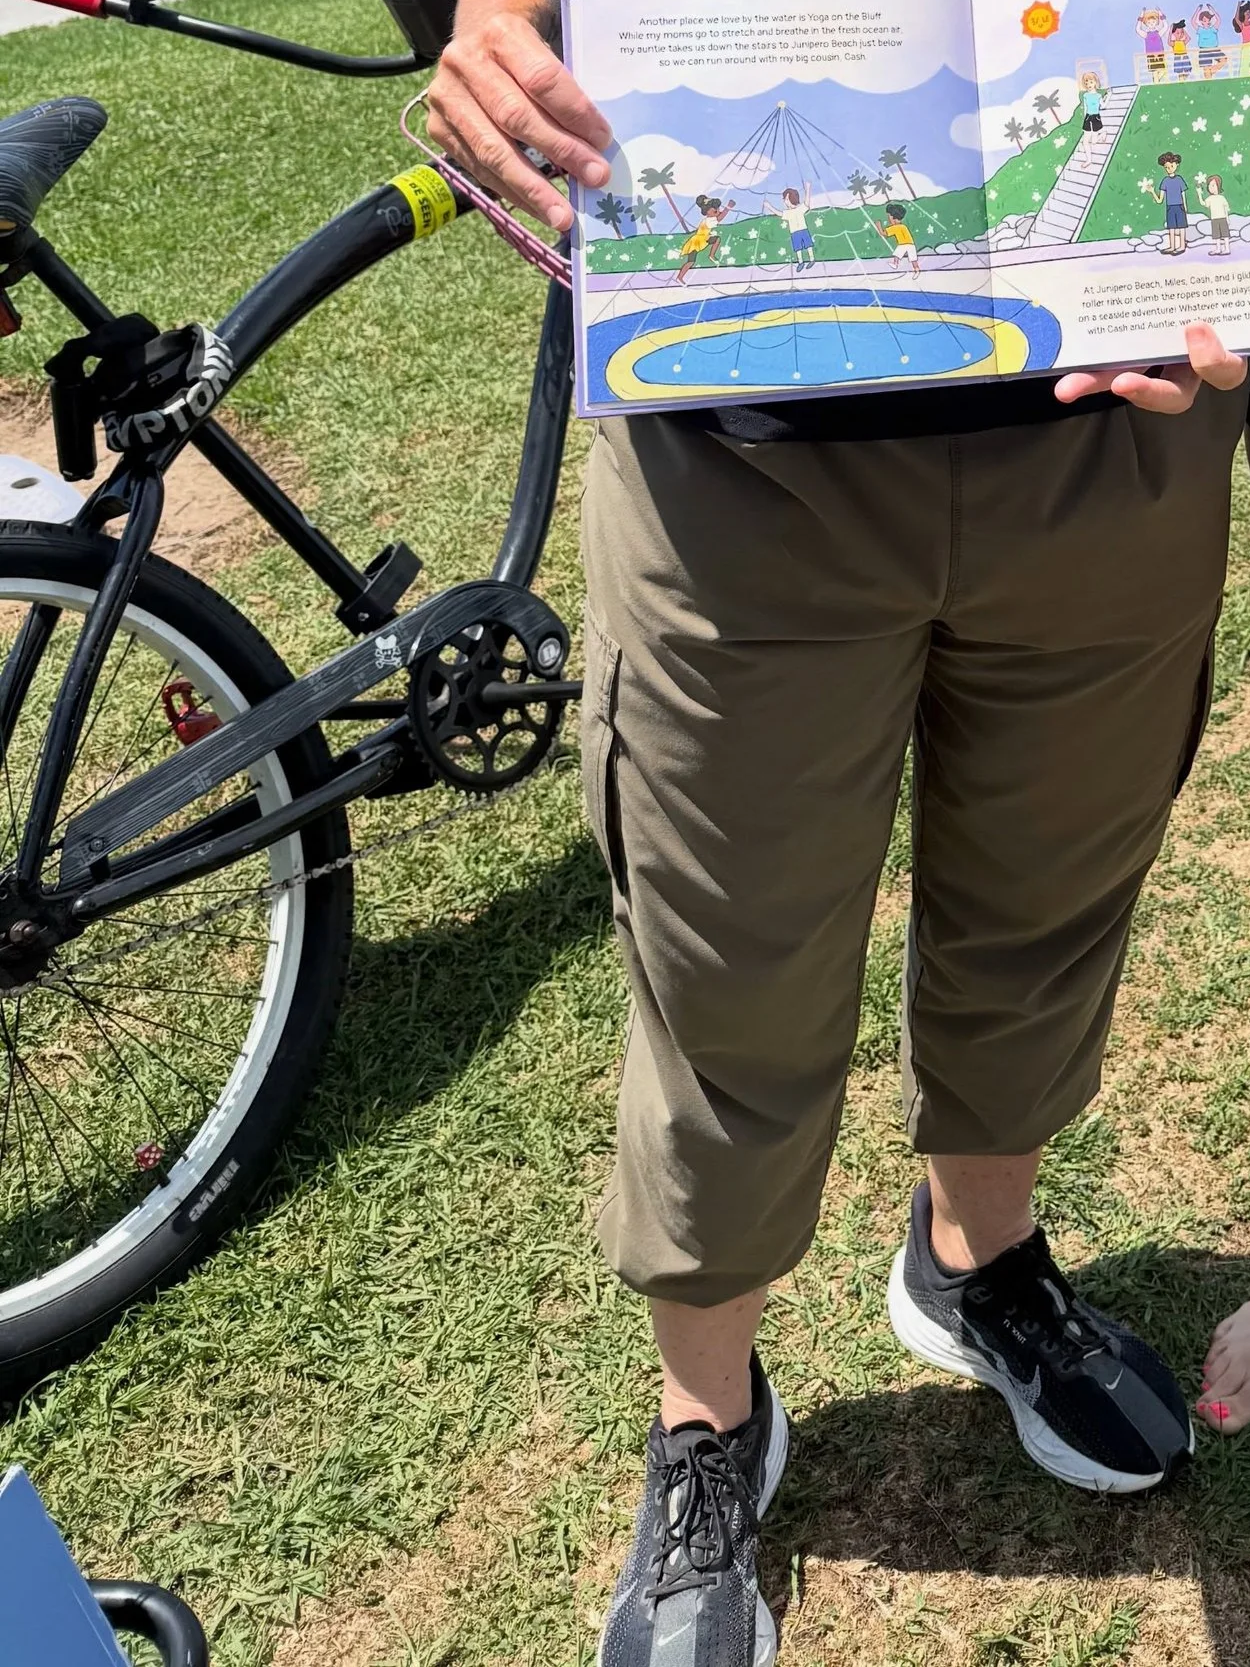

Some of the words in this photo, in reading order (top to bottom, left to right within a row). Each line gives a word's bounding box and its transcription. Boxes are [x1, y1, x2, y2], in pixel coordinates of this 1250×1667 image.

[638, 17, 677, 26] Another
[679, 16, 704, 26] place
[721, 15, 740, 24] love
[742, 15, 753, 25] by
[754, 14, 769, 23] the
[771, 14, 796, 22] water
[808, 13, 829, 23] Yoga
[845, 12, 860, 21] the
[619, 31, 643, 40] While
[646, 32, 661, 41] my
[663, 31, 694, 39] moms
[695, 31, 707, 40] go
[709, 30, 720, 38] to
[721, 29, 755, 37] stretch
[757, 28, 773, 36] and
[775, 27, 809, 36] breathe
[811, 27, 819, 35] in
[821, 26, 836, 34] the
[838, 25, 861, 34] fresh
[862, 26, 889, 34] ocean
[620, 47, 635, 56] my
[637, 45, 666, 54] auntie
[668, 44, 693, 53] takes
[695, 44, 705, 52] us
[707, 43, 733, 52] down
[735, 42, 750, 51] the
[779, 41, 789, 49] to
[791, 40, 829, 50] Junipero
[831, 39, 858, 48] Beach
[860, 39, 876, 49] just
[878, 38, 903, 47] below
[659, 59, 670, 67] so
[672, 58, 686, 66] we
[687, 57, 705, 66] can
[706, 57, 723, 65] run
[724, 55, 756, 64] around
[759, 55, 778, 64] with
[780, 55, 794, 64] my
[796, 54, 809, 64] big
[1083, 286, 1095, 295] At
[1096, 283, 1133, 294] Junipero
[1214, 273, 1230, 283] and
[1082, 299, 1104, 309] roller
[1106, 297, 1123, 306] rink
[1124, 296, 1133, 304] or
[1135, 294, 1159, 304] climb
[1161, 292, 1175, 301] the
[1177, 290, 1201, 300] ropes
[1202, 288, 1214, 297] on
[1215, 287, 1230, 295] the
[1078, 314, 1090, 323] on
[1179, 301, 1219, 313] Whatever
[1220, 300, 1233, 309] we
[1234, 299, 1246, 308] do
[1087, 325, 1106, 335] with
[1107, 323, 1128, 334] Cash
[1130, 321, 1146, 331] and
[1222, 313, 1242, 322] have
[188, 1158, 241, 1222] nirve
